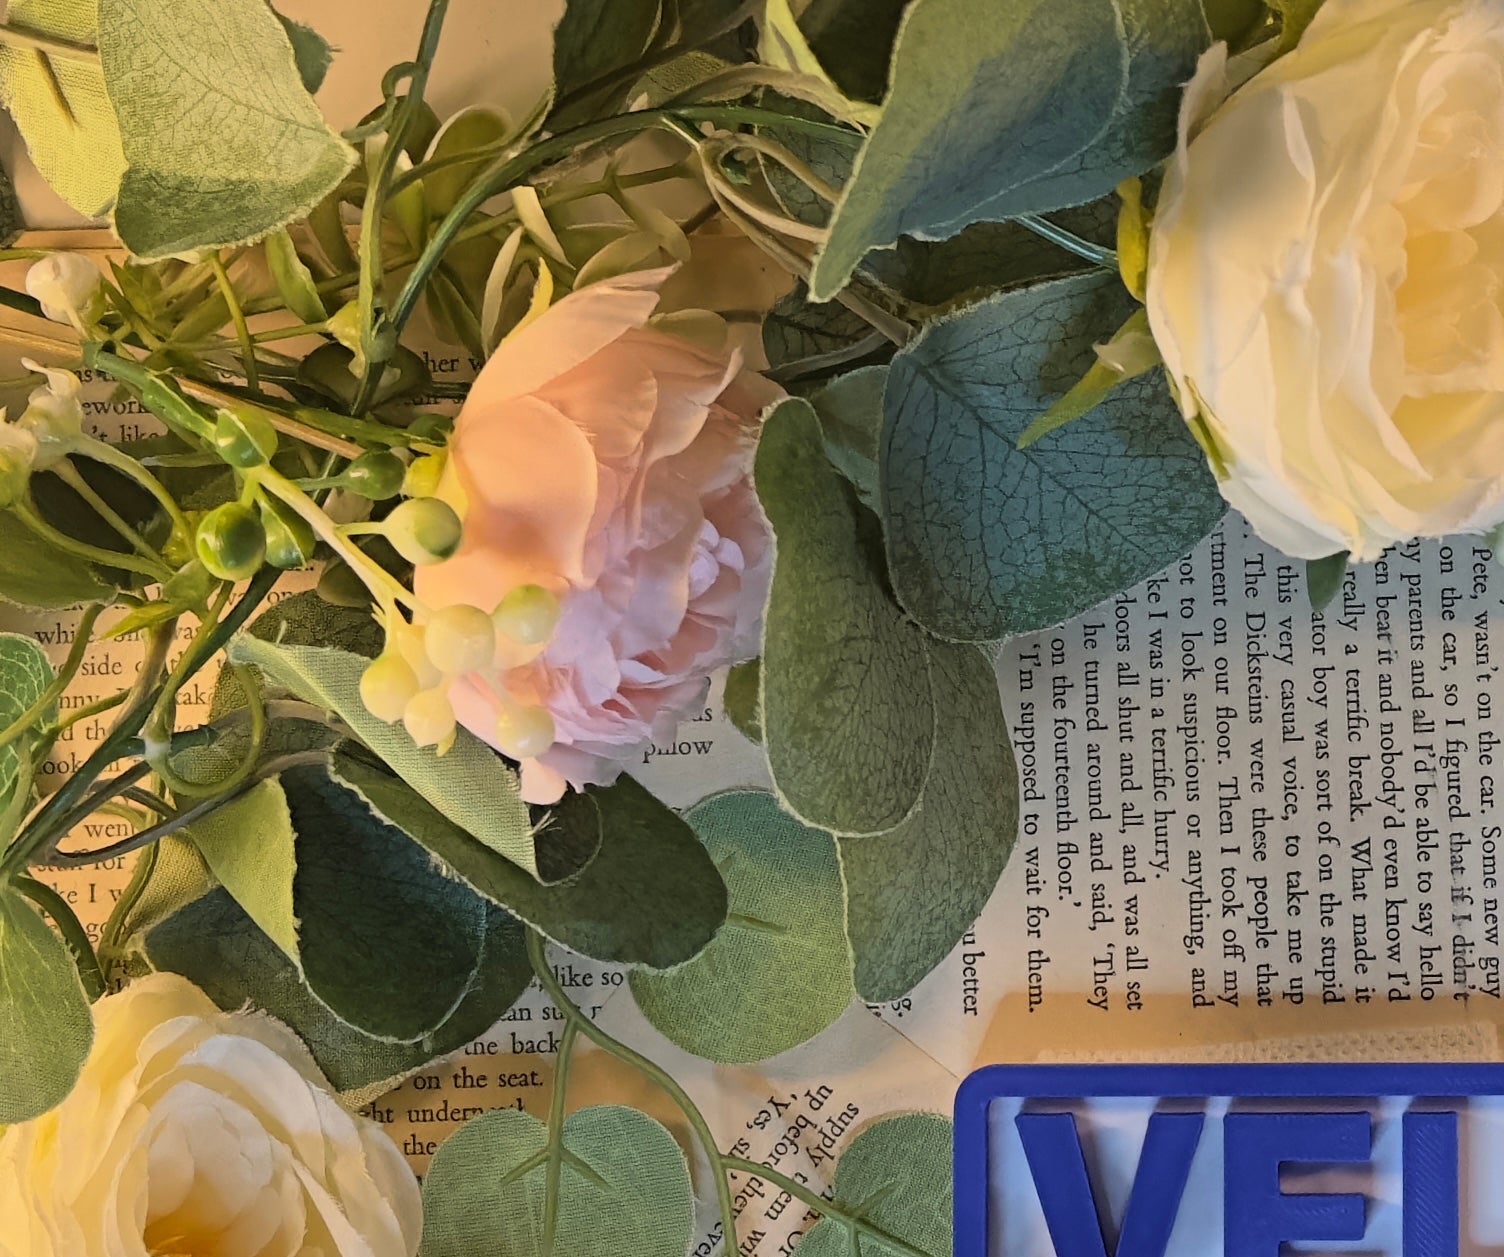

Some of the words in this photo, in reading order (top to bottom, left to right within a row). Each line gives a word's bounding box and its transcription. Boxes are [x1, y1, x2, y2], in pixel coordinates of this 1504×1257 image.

[1243, 553, 1267, 599] The
[1334, 569, 1366, 632] really
[1400, 572, 1426, 651] parents
[1244, 610, 1269, 724] Dicksteins
[1343, 643, 1358, 656] a
[1409, 658, 1434, 701] and
[1344, 668, 1370, 742] terrific
[1411, 708, 1436, 735] all
[1015, 701, 1046, 803] supposed
[1249, 737, 1264, 793] were
[1347, 753, 1373, 822] break.
[1413, 780, 1438, 809] be
[1023, 812, 1040, 835] to
[1250, 806, 1275, 862] these
[1414, 816, 1439, 863] able
[1024, 845, 1047, 896] wait
[1349, 835, 1374, 901] What
[1416, 870, 1433, 893] to
[1025, 904, 1050, 939] for
[1245, 875, 1278, 949] people
[1410, 901, 1433, 937] say
[1351, 912, 1377, 975] made
[601, 971, 624, 988] so
[961, 950, 985, 1017] better
[1026, 948, 1051, 1013] them.
[1255, 962, 1279, 1007] that
[1353, 985, 1376, 1004] it
[1418, 944, 1443, 1001] hello
[512, 1032, 560, 1054] back
[413, 1074, 442, 1090] on
[453, 1067, 487, 1089] the
[498, 1071, 544, 1088] seat.
